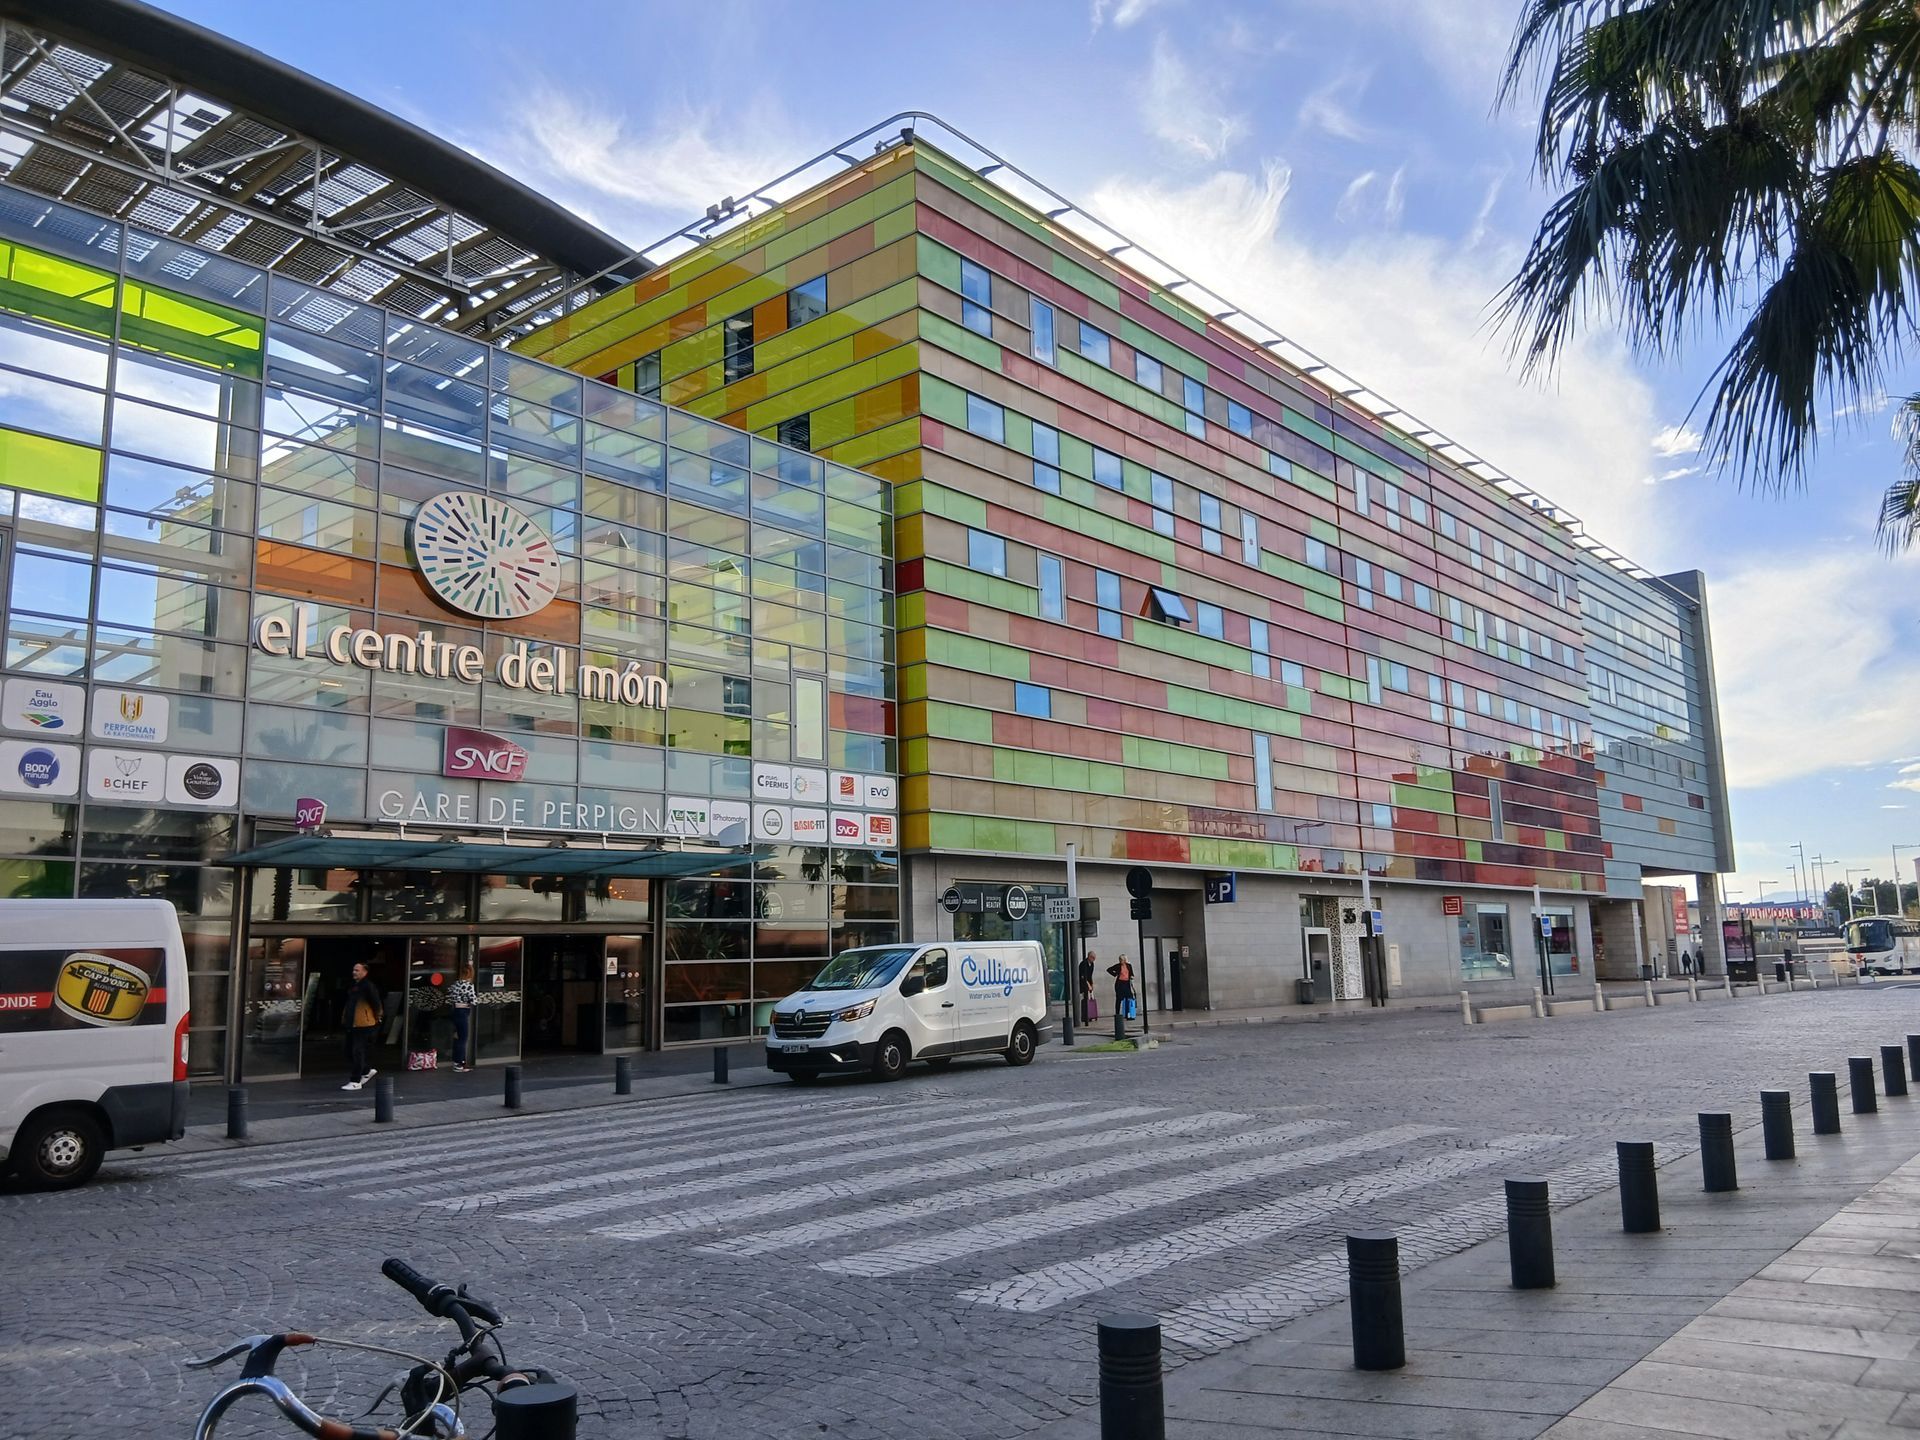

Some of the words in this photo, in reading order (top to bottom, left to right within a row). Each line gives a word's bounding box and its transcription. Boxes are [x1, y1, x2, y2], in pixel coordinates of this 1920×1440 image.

[255, 602, 308, 659] el
[325, 624, 485, 685] centre
[496, 639, 567, 695] del
[578, 661, 668, 711] món
[35, 689, 53, 700] Eau
[29, 699, 58, 708] Agglo
[104, 722, 156, 735] PERPIGNAN
[451, 746, 526, 775] SNCF
[25, 763, 51, 773] BODY
[24, 771, 49, 780] minute
[765, 780, 789, 790] PERMIS
[297, 806, 324, 826] SNCF
[379, 790, 470, 823] GARE
[489, 799, 525, 824] DE
[543, 801, 700, 834] PERPIGNAN
[794, 820, 825, 831] BASIC-FIT
[837, 826, 857, 835] SNCF
[1219, 882, 1231, 901] P
[83, 969, 103, 983] CAP
[102, 975, 130, 989] D'ONA
[960, 955, 1029, 997] Culligan
[969, 992, 982, 1000] Water
